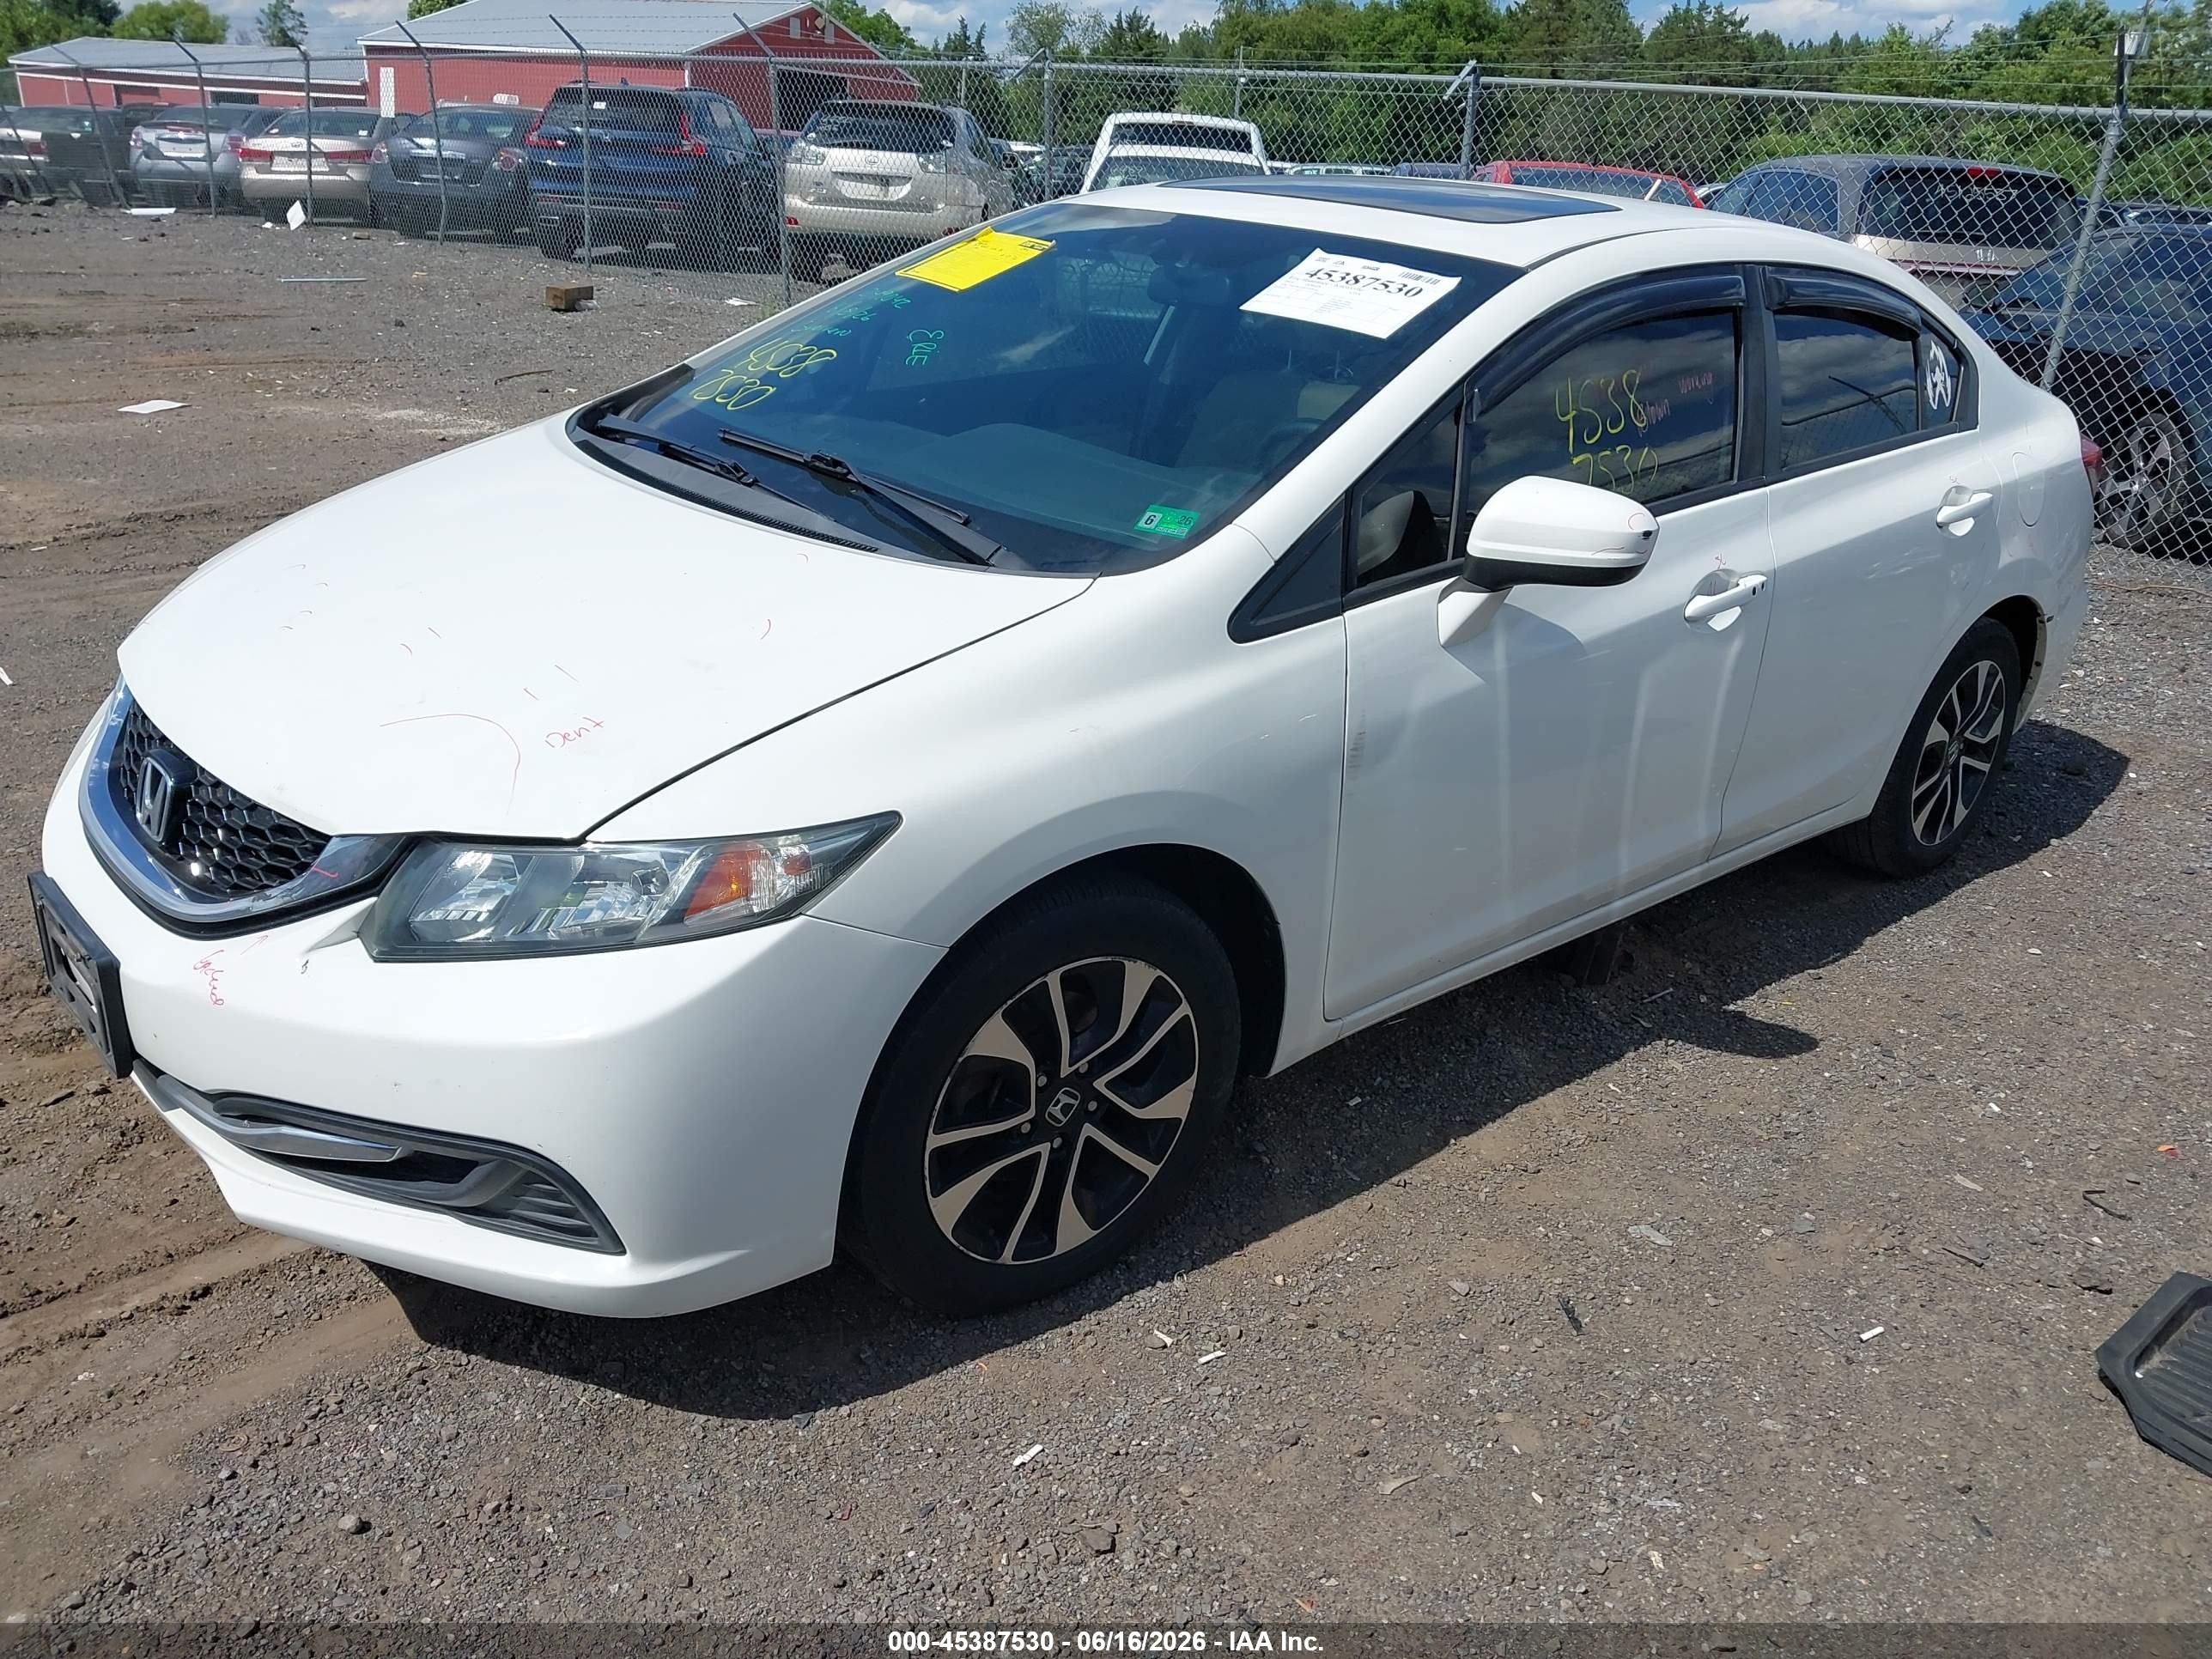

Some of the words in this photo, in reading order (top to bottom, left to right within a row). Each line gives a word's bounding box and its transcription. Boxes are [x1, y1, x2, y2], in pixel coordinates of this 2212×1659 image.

[1305, 267, 1424, 298] 45387530
[734, 337, 837, 378] 4538
[690, 368, 776, 410] 7530
[1555, 369, 1648, 454] 4538
[1145, 514, 1157, 526] 6
